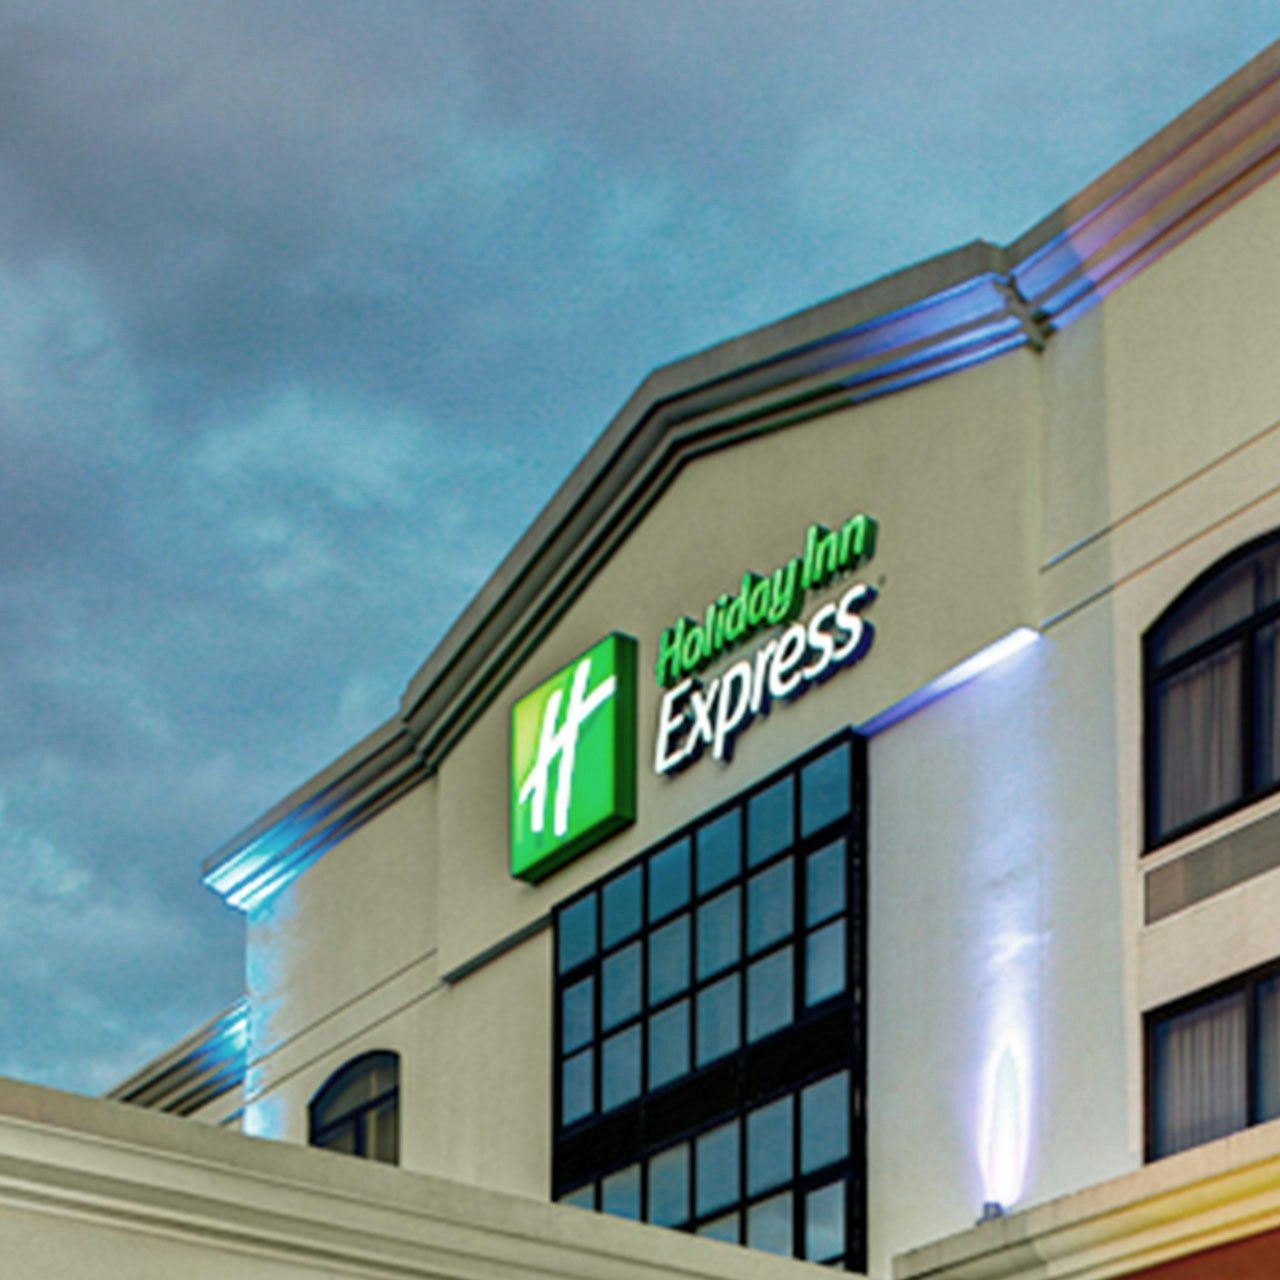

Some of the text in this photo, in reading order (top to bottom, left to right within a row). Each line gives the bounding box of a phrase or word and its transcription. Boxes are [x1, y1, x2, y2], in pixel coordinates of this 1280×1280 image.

[655, 513, 873, 686] Holiday Inn
[655, 583, 871, 775] Express
